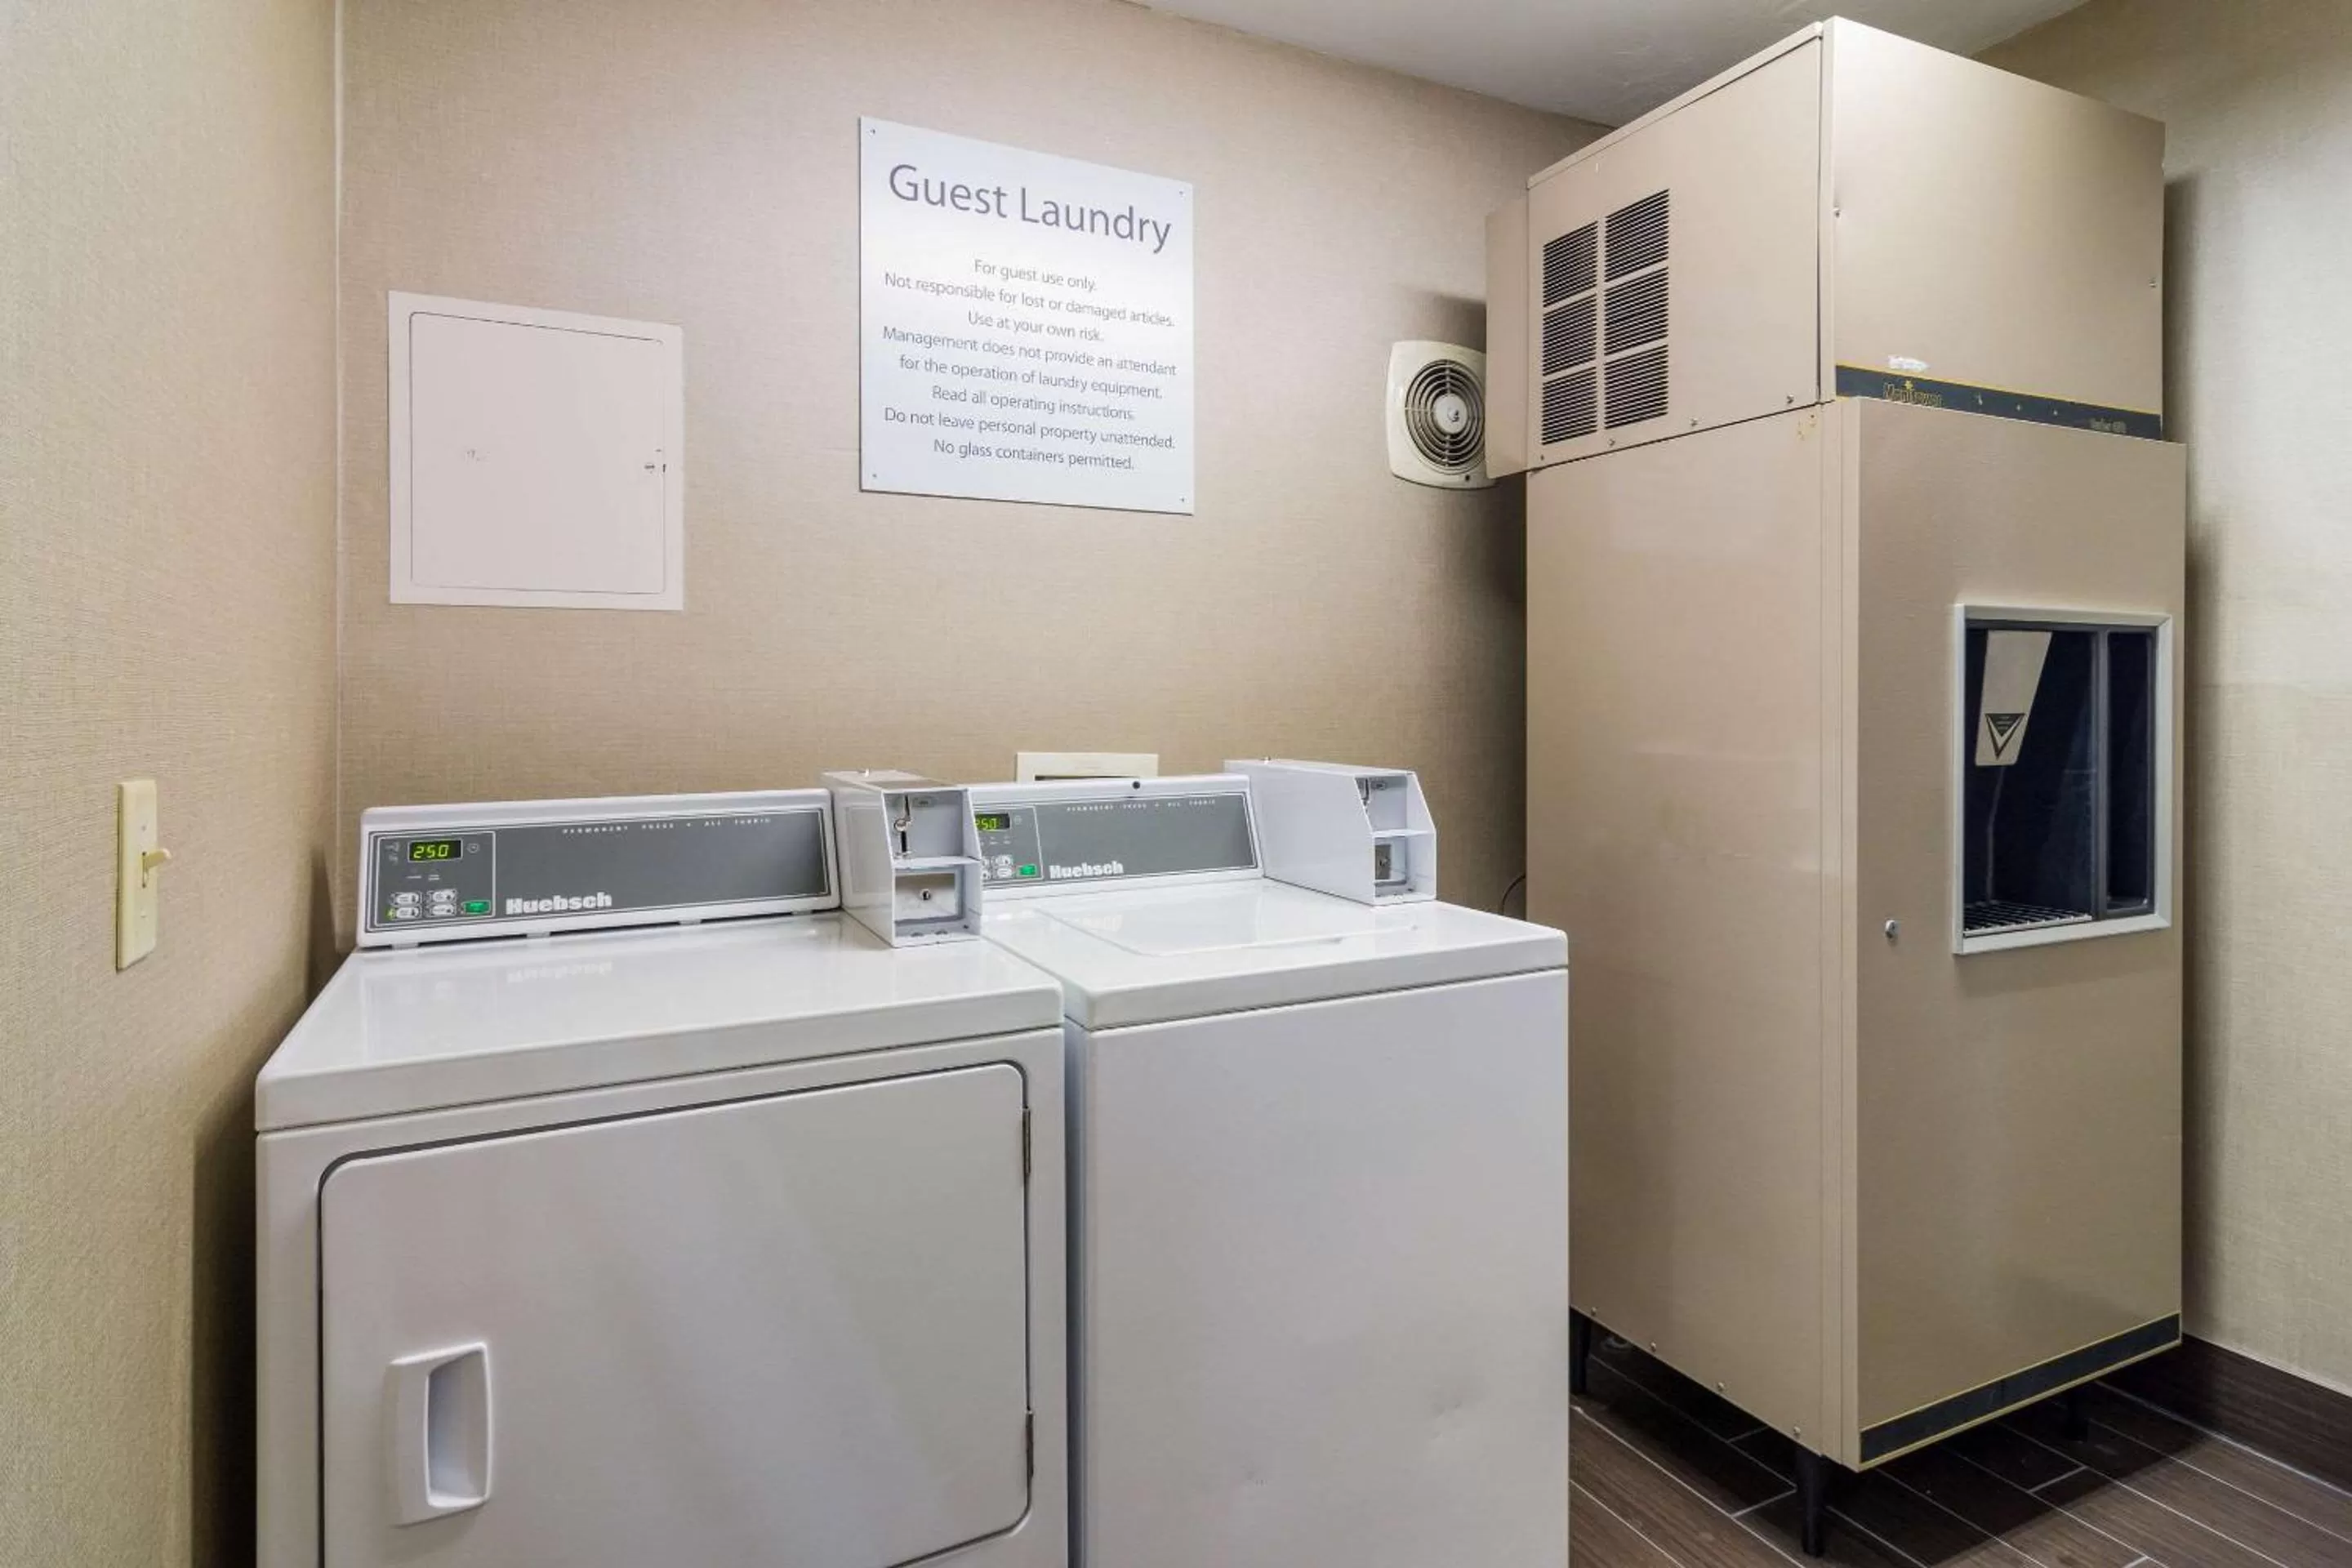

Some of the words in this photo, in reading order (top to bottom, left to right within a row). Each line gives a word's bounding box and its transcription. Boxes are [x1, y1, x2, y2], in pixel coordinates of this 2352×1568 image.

[889, 163, 1008, 218] Guest
[1021, 188, 1171, 254] Laundry
[974, 259, 996, 276] For
[1000, 263, 1037, 282] guest
[1041, 271, 1063, 285] use
[885, 272, 911, 289] Not
[915, 277, 995, 301] responsible
[999, 287, 1018, 305] for
[1021, 292, 1044, 310] lost
[1049, 298, 1062, 311] or
[1065, 300, 1127, 324] damaged
[1129, 308, 1175, 327] articles.
[968, 310, 993, 327] Use
[996, 315, 1009, 328] at
[1013, 319, 1044, 336] your
[1047, 324, 1076, 337] own
[883, 327, 978, 351] Management
[982, 339, 1016, 356] does
[1019, 346, 1041, 360] not
[1045, 347, 1095, 366] provide
[1098, 356, 1113, 369] an
[1116, 357, 1178, 376] attendant
[899, 354, 920, 371] for
[924, 358, 948, 374] the
[951, 363, 1018, 383] operation
[1021, 370, 1036, 385] of
[1039, 372, 1088, 393] laundry
[1090, 380, 1163, 400] equipment.
[932, 385, 967, 402] Read
[971, 390, 987, 404] all
[990, 394, 1055, 414] operating
[884, 407, 906, 423] Do
[910, 410, 934, 425] not
[938, 413, 974, 430] leave
[979, 417, 1036, 437] personal
[1040, 424, 1097, 444] property
[1100, 430, 1175, 449] unattended.
[933, 439, 955, 453] No
[959, 441, 992, 459] glass
[996, 447, 1064, 464] containers
[1068, 452, 1134, 472] permitted.
[413, 844, 449, 858] 250
[1049, 861, 1124, 879] Huebsch
[506, 892, 612, 915] Huebsch
